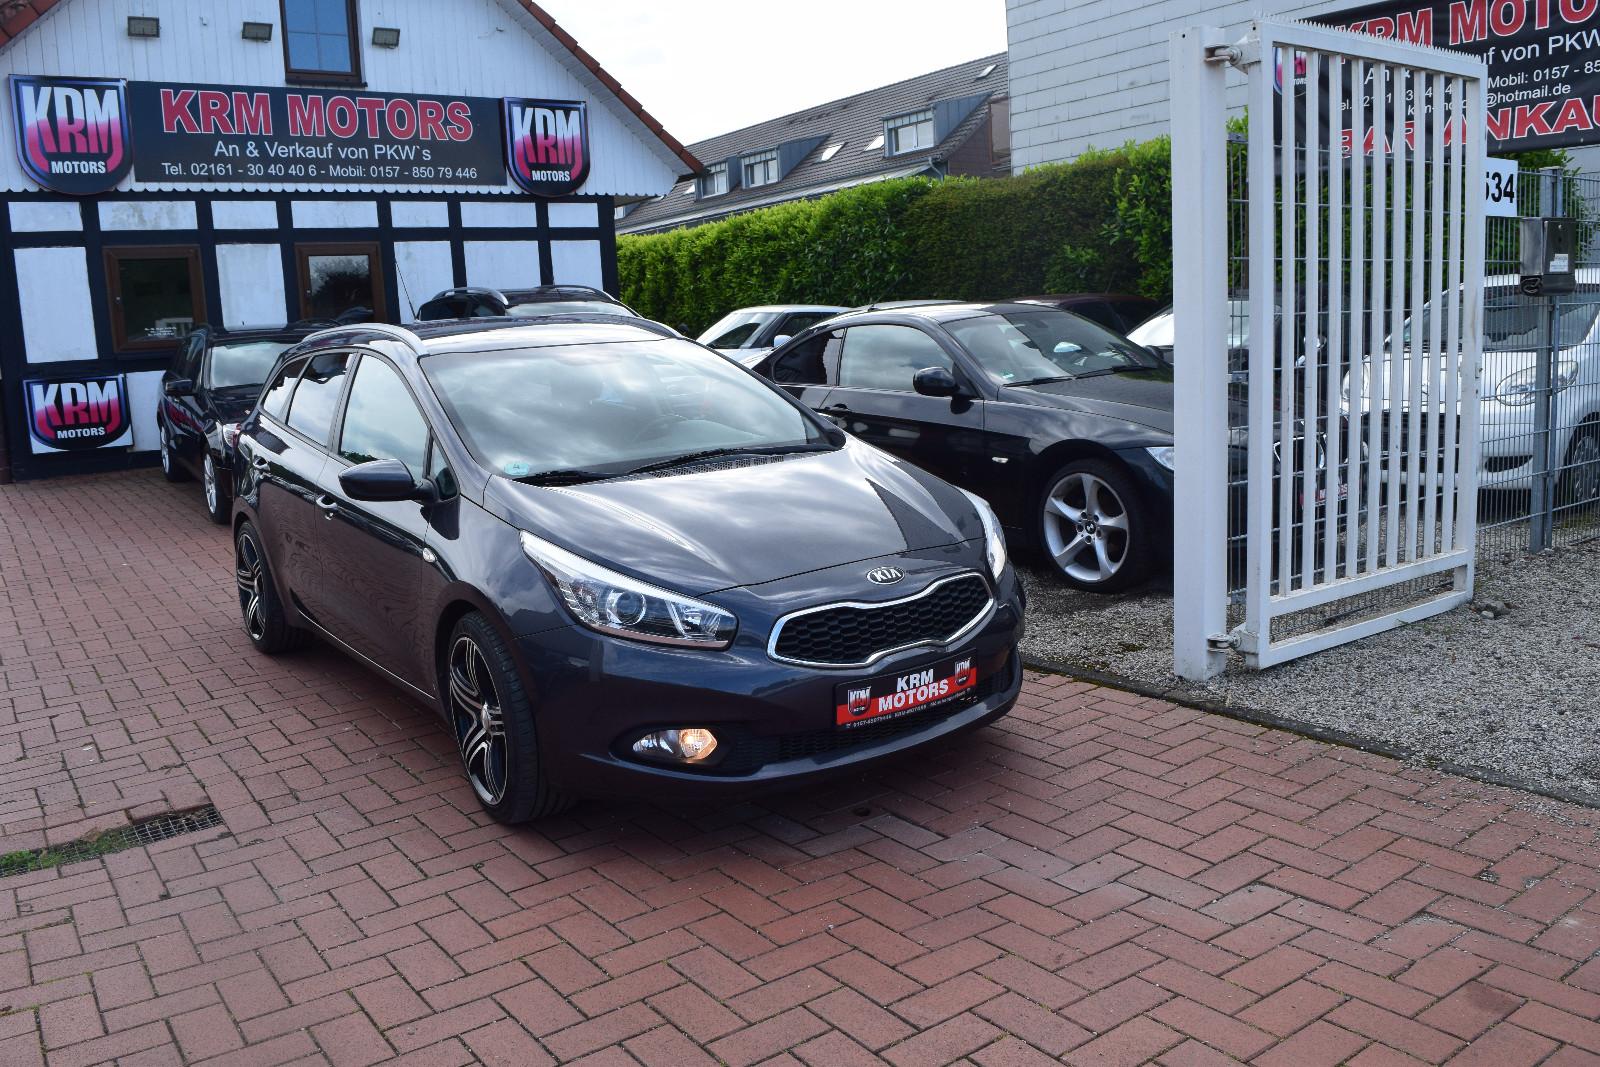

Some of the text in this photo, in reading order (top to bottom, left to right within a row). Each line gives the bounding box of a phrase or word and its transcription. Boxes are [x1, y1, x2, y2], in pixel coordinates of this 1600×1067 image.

[1500, 43, 1540, 63] von
[1487, 72, 1529, 89] Mobil:
[1533, 64, 1570, 82] 0157
[22, 85, 124, 155] KRM
[160, 89, 474, 142] KRM MOTORS
[512, 106, 582, 166] KRM
[214, 140, 240, 158] An
[246, 141, 259, 158] &
[264, 141, 334, 160] Verkauf
[337, 147, 370, 160] von
[51, 160, 107, 175] MOTORS
[162, 162, 187, 176] Tel.
[190, 163, 233, 176] 02161
[247, 163, 264, 177] 30
[267, 163, 285, 177] 40
[288, 163, 306, 177] 40
[308, 164, 317, 177] 6
[329, 164, 366, 178] Mobil:
[370, 165, 400, 179] 0157
[412, 166, 435, 179] 850
[438, 167, 453, 180] 79
[455, 167, 478, 180] 446
[531, 170, 571, 183] MOTORS
[33, 380, 121, 430] KRM
[57, 426, 106, 440] MOTORS
[872, 568, 902, 582] KIA
[896, 668, 934, 693] KRM
[878, 678, 949, 713] MOTORS
